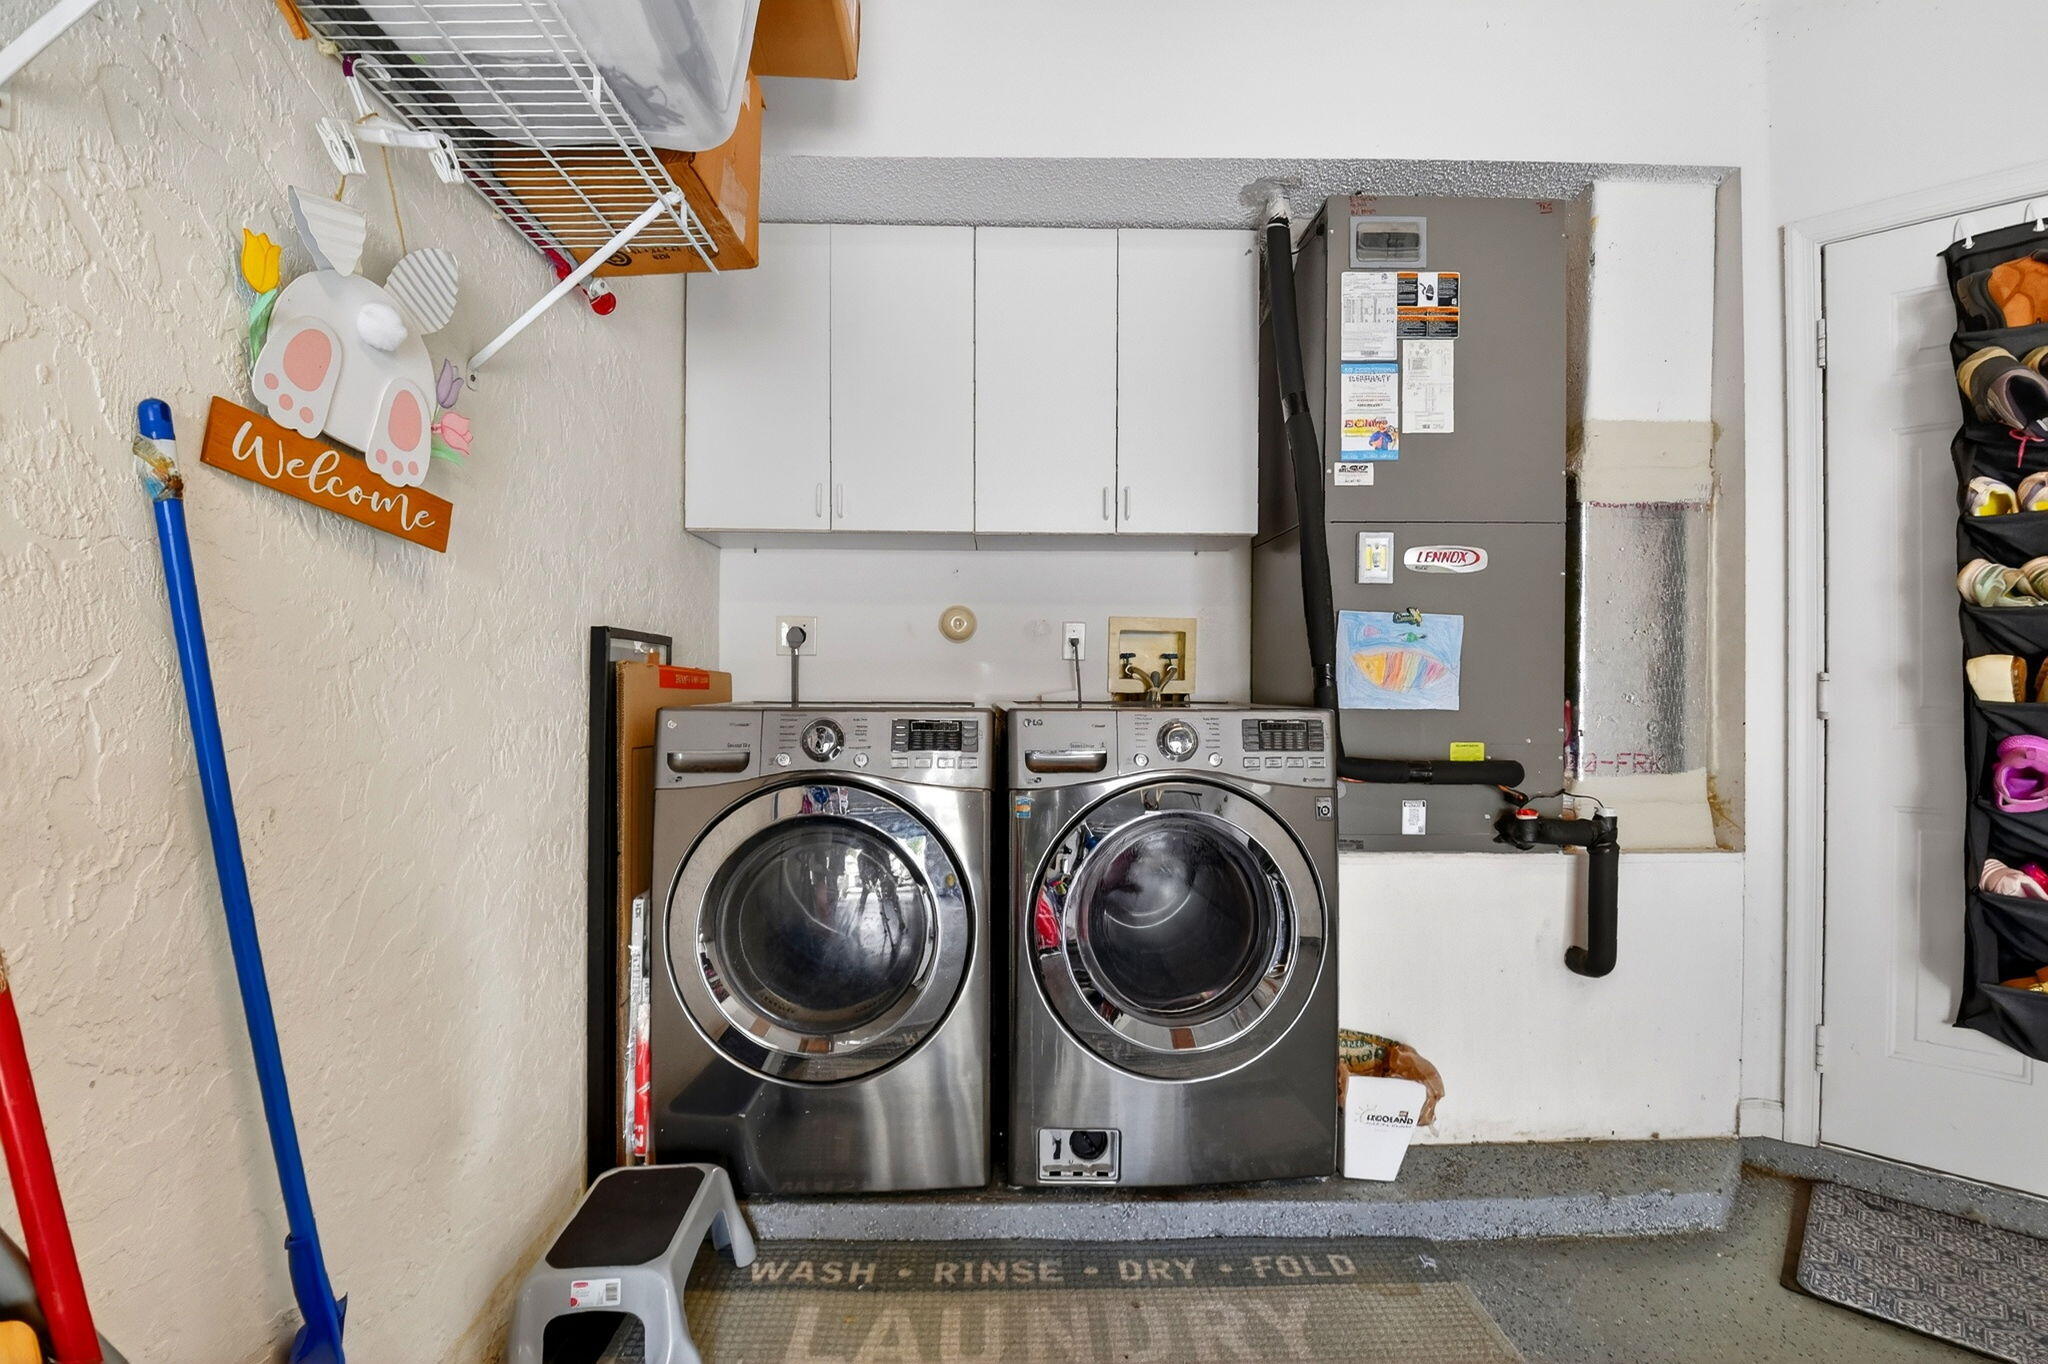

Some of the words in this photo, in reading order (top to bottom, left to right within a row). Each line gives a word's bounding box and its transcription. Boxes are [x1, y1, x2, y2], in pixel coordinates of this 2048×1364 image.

[231, 420, 436, 532] Welcome
[1416, 551, 1469, 564] LENNOX
[1367, 1114, 1414, 1125] LEGOLAND
[751, 1261, 877, 1284] WASH
[933, 1261, 1065, 1284] RINSE
[1118, 1257, 1198, 1281] DRY
[1247, 1254, 1357, 1279] FOLD
[784, 1302, 1311, 1364] LAUNDRY
